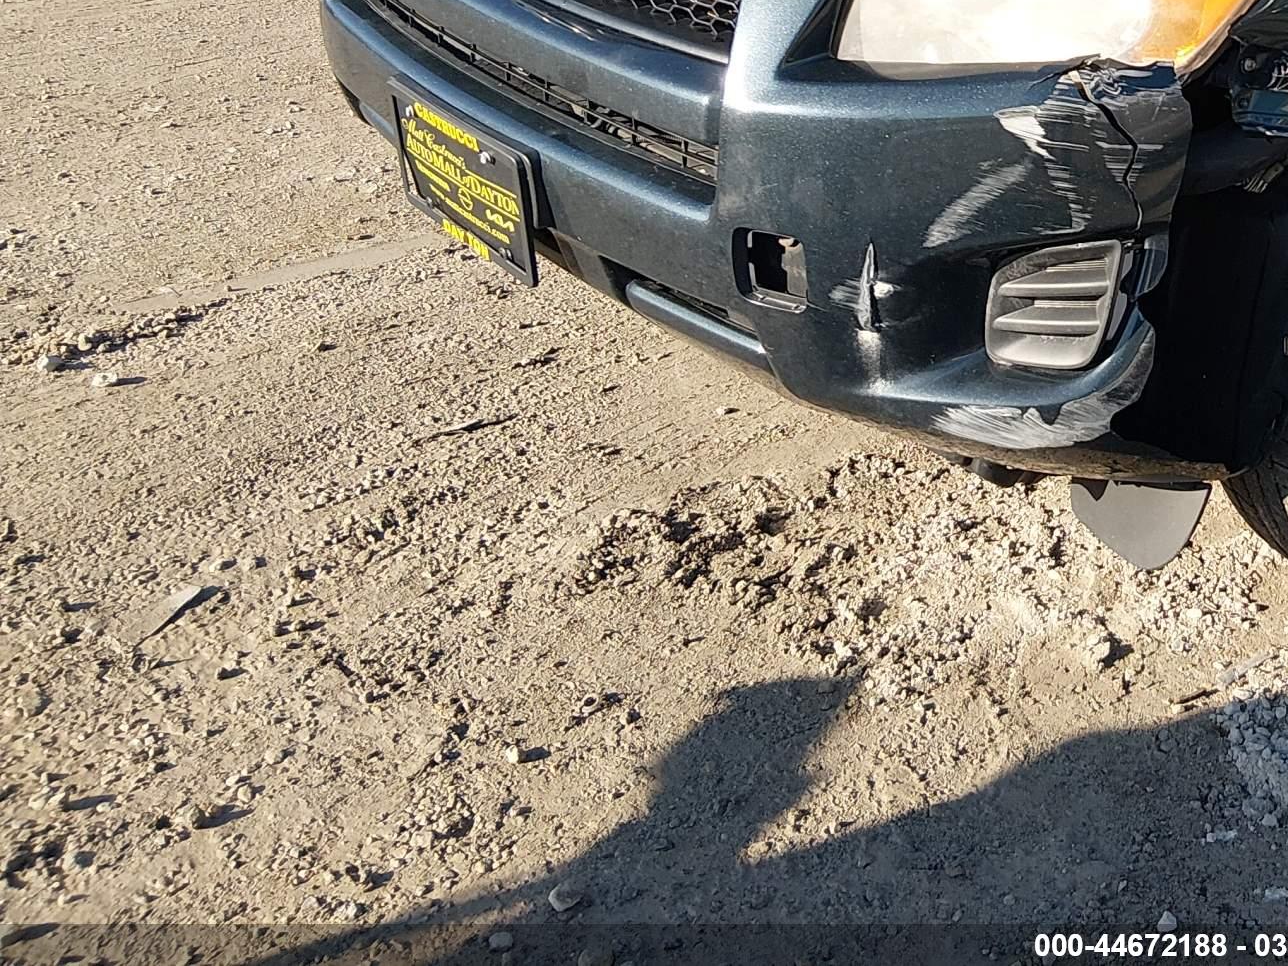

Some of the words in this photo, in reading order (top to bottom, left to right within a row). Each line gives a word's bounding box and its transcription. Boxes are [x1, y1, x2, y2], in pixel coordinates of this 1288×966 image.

[401, 118, 425, 140] Matt
[413, 101, 480, 152] CASTRUCCI
[469, 174, 520, 216] DAYTON
